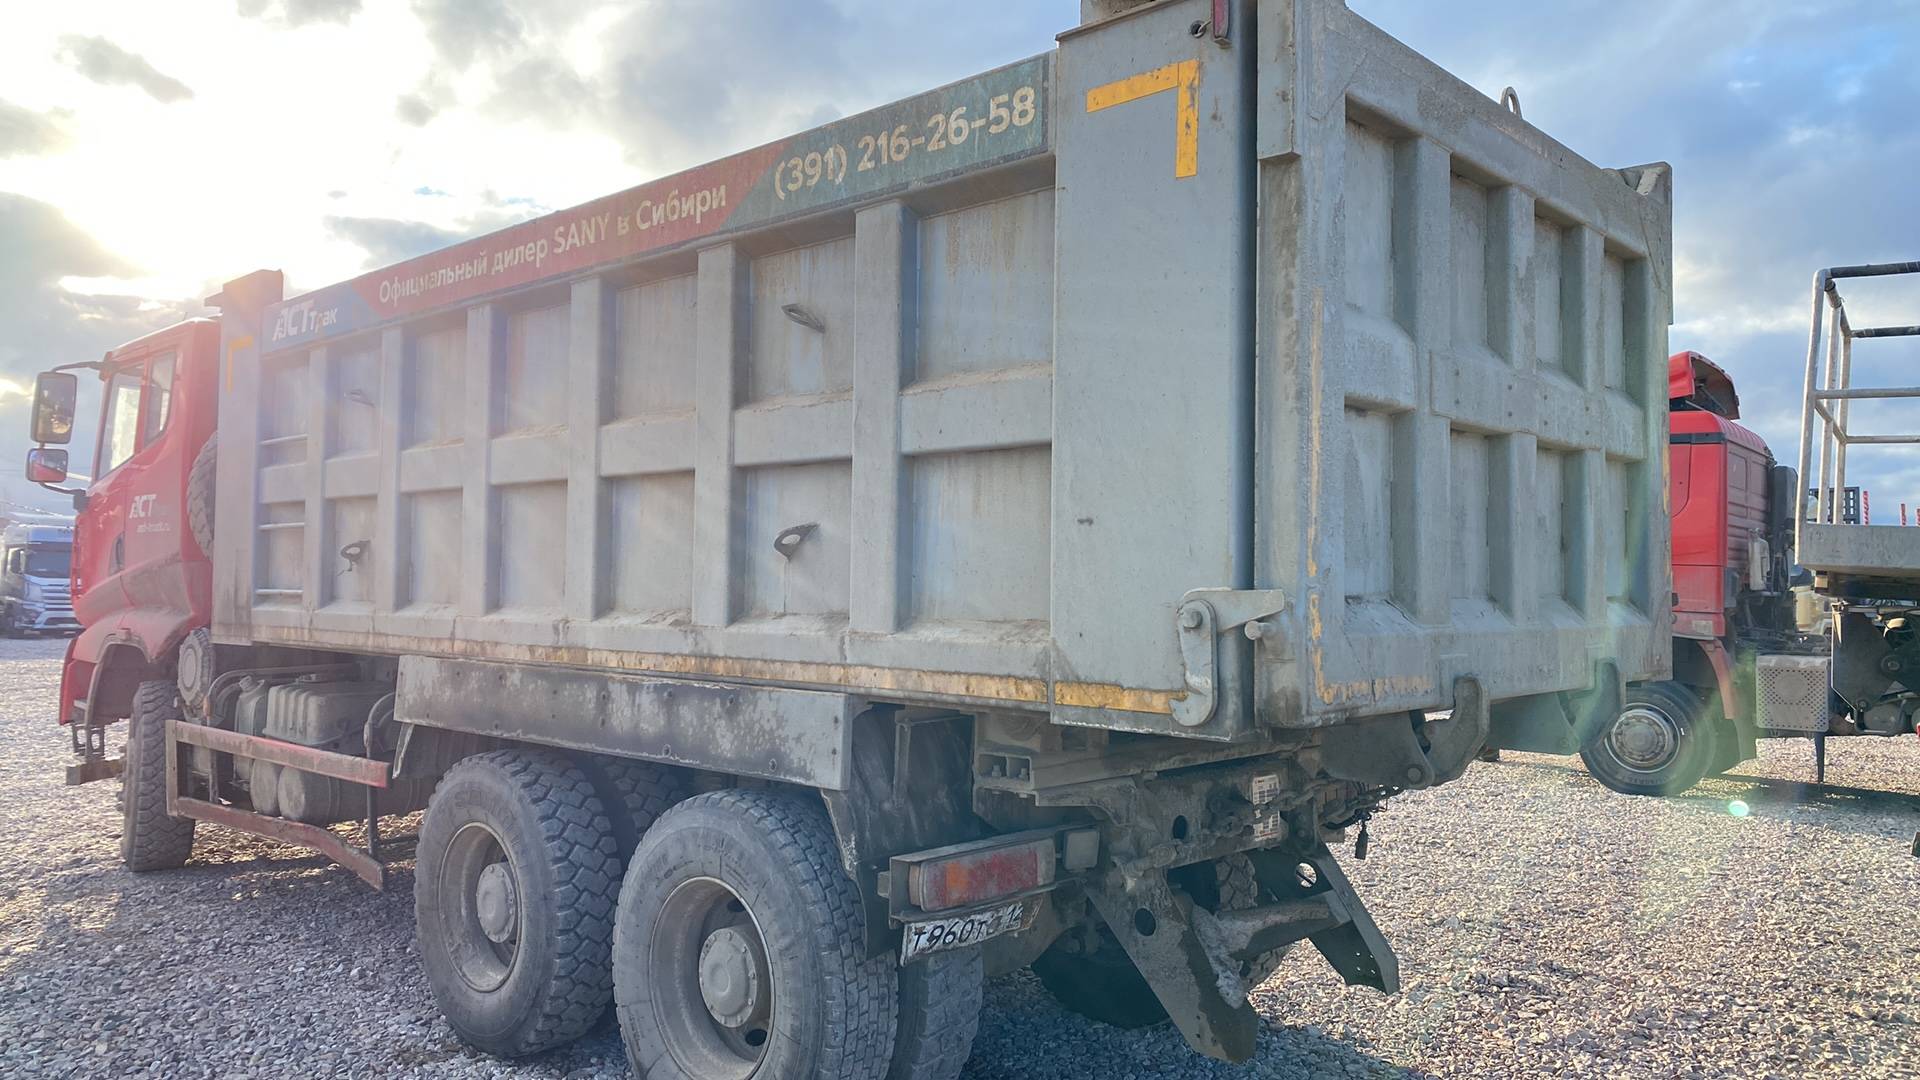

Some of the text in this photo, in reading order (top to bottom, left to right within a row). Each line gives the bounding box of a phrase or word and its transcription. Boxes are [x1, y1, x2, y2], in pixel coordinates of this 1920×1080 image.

[774, 86, 1036, 200] (391) 216-26-58
[379, 184, 727, 307] Официальный дилер SANY в Сибири
